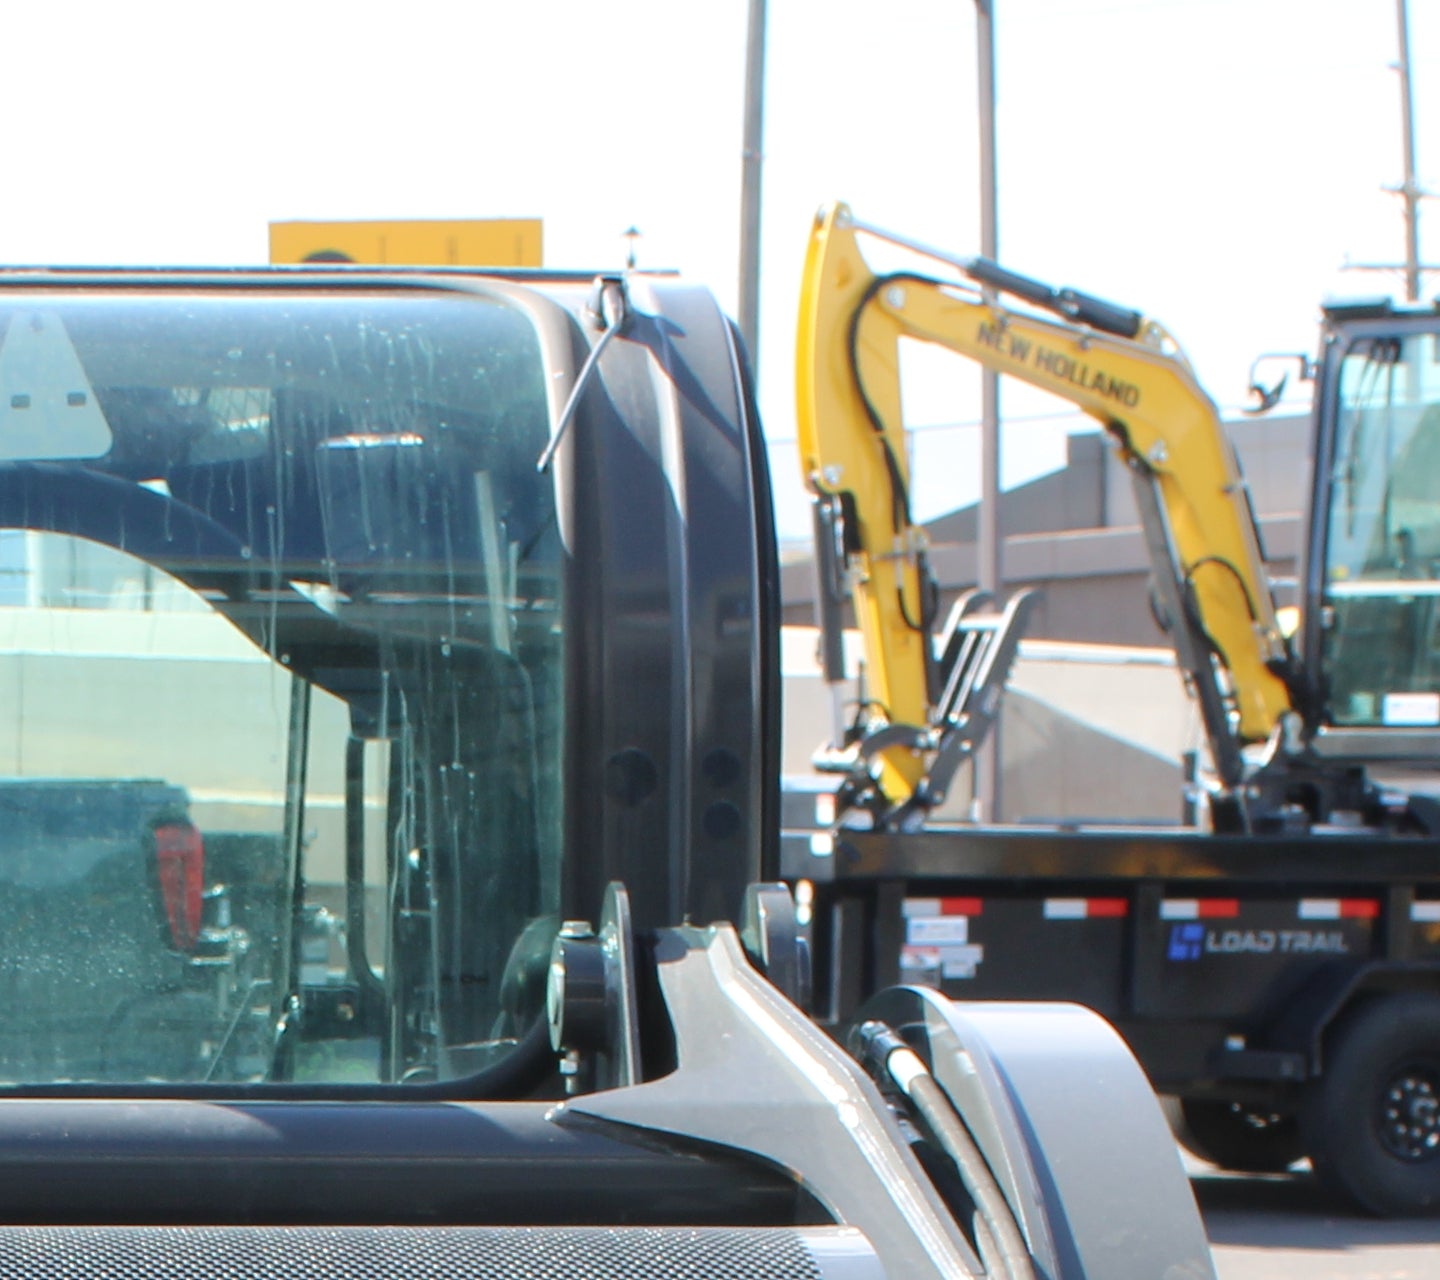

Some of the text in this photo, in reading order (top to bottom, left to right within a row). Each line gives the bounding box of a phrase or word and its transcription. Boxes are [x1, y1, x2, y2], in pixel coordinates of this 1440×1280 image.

[977, 321, 1139, 408] NEW HOLLAND
[1205, 930, 1349, 954] LOAD TRAIL
